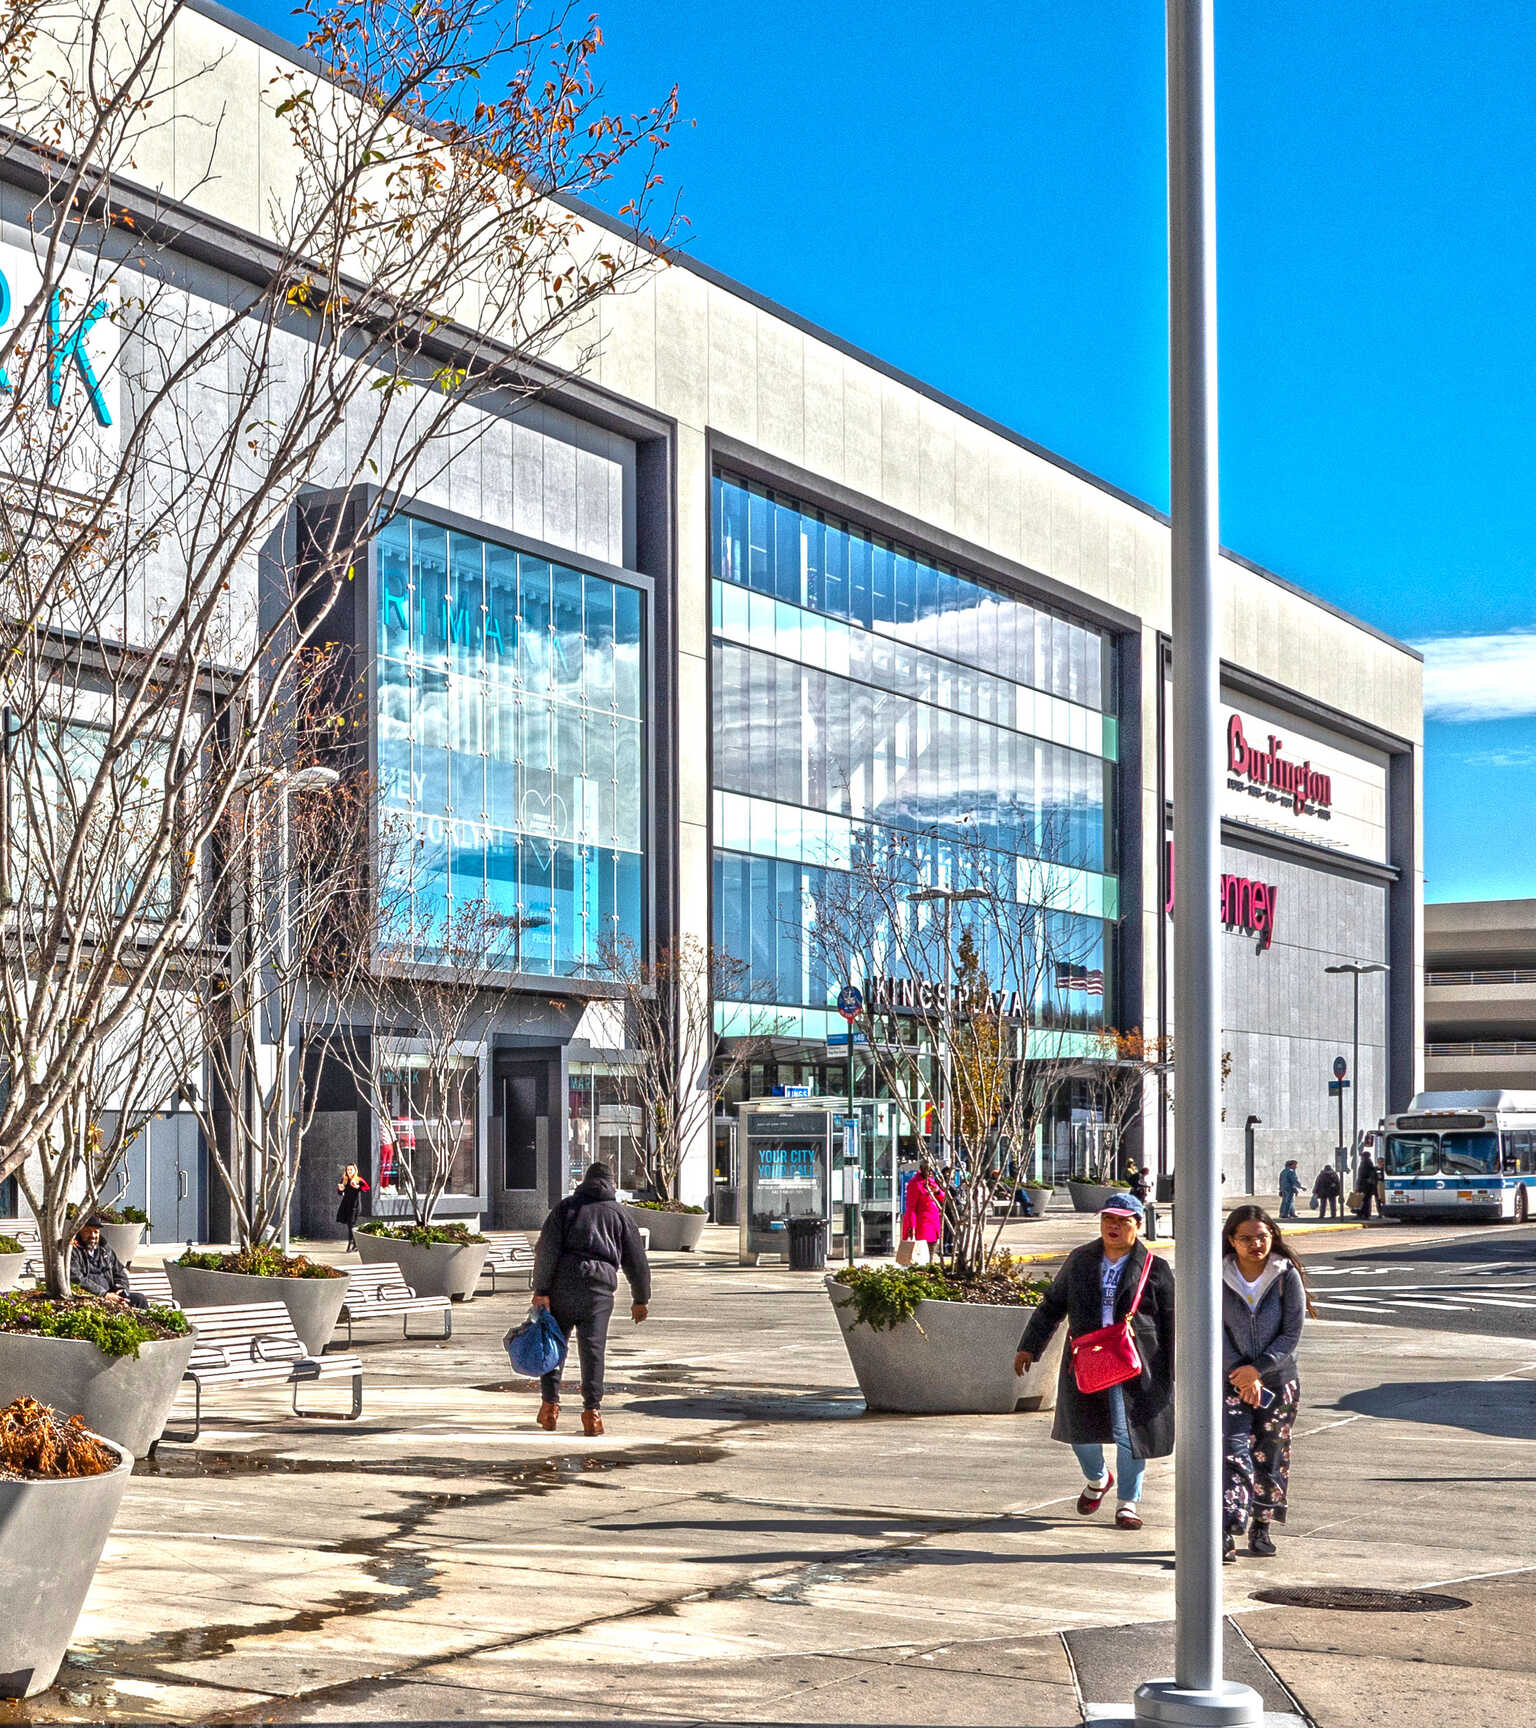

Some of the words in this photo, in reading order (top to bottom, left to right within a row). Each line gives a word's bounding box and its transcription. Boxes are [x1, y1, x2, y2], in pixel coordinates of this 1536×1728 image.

[384, 569, 569, 673] RIMA
[1227, 714, 1332, 816] Burlington
[872, 975, 947, 1012] KINGS
[956, 983, 1023, 1018] PLAZA
[759, 1150, 787, 1163] YOUR
[759, 1165, 786, 1178] YOUR
